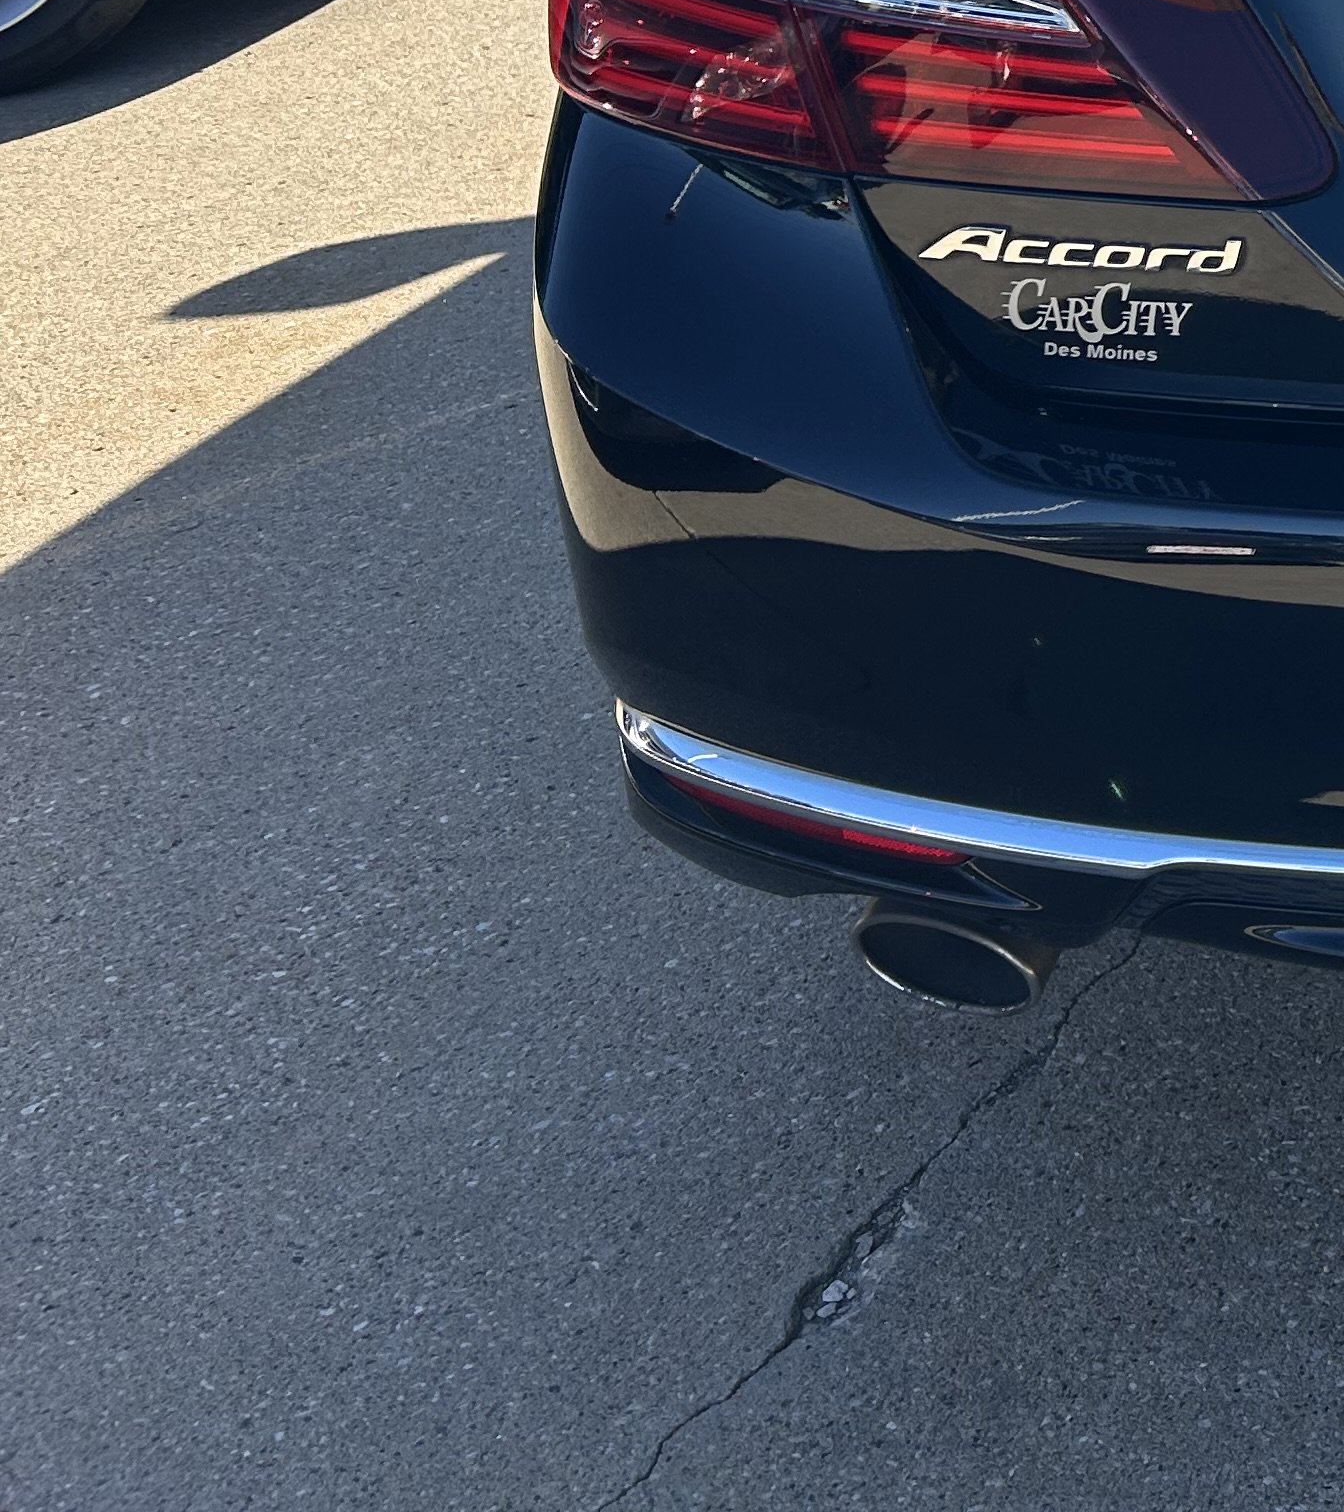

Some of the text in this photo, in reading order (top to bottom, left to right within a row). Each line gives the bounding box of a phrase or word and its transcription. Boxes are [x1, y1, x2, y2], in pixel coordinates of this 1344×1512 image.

[918, 225, 1243, 273] Accord
[1044, 342, 1158, 362] Des Moines
